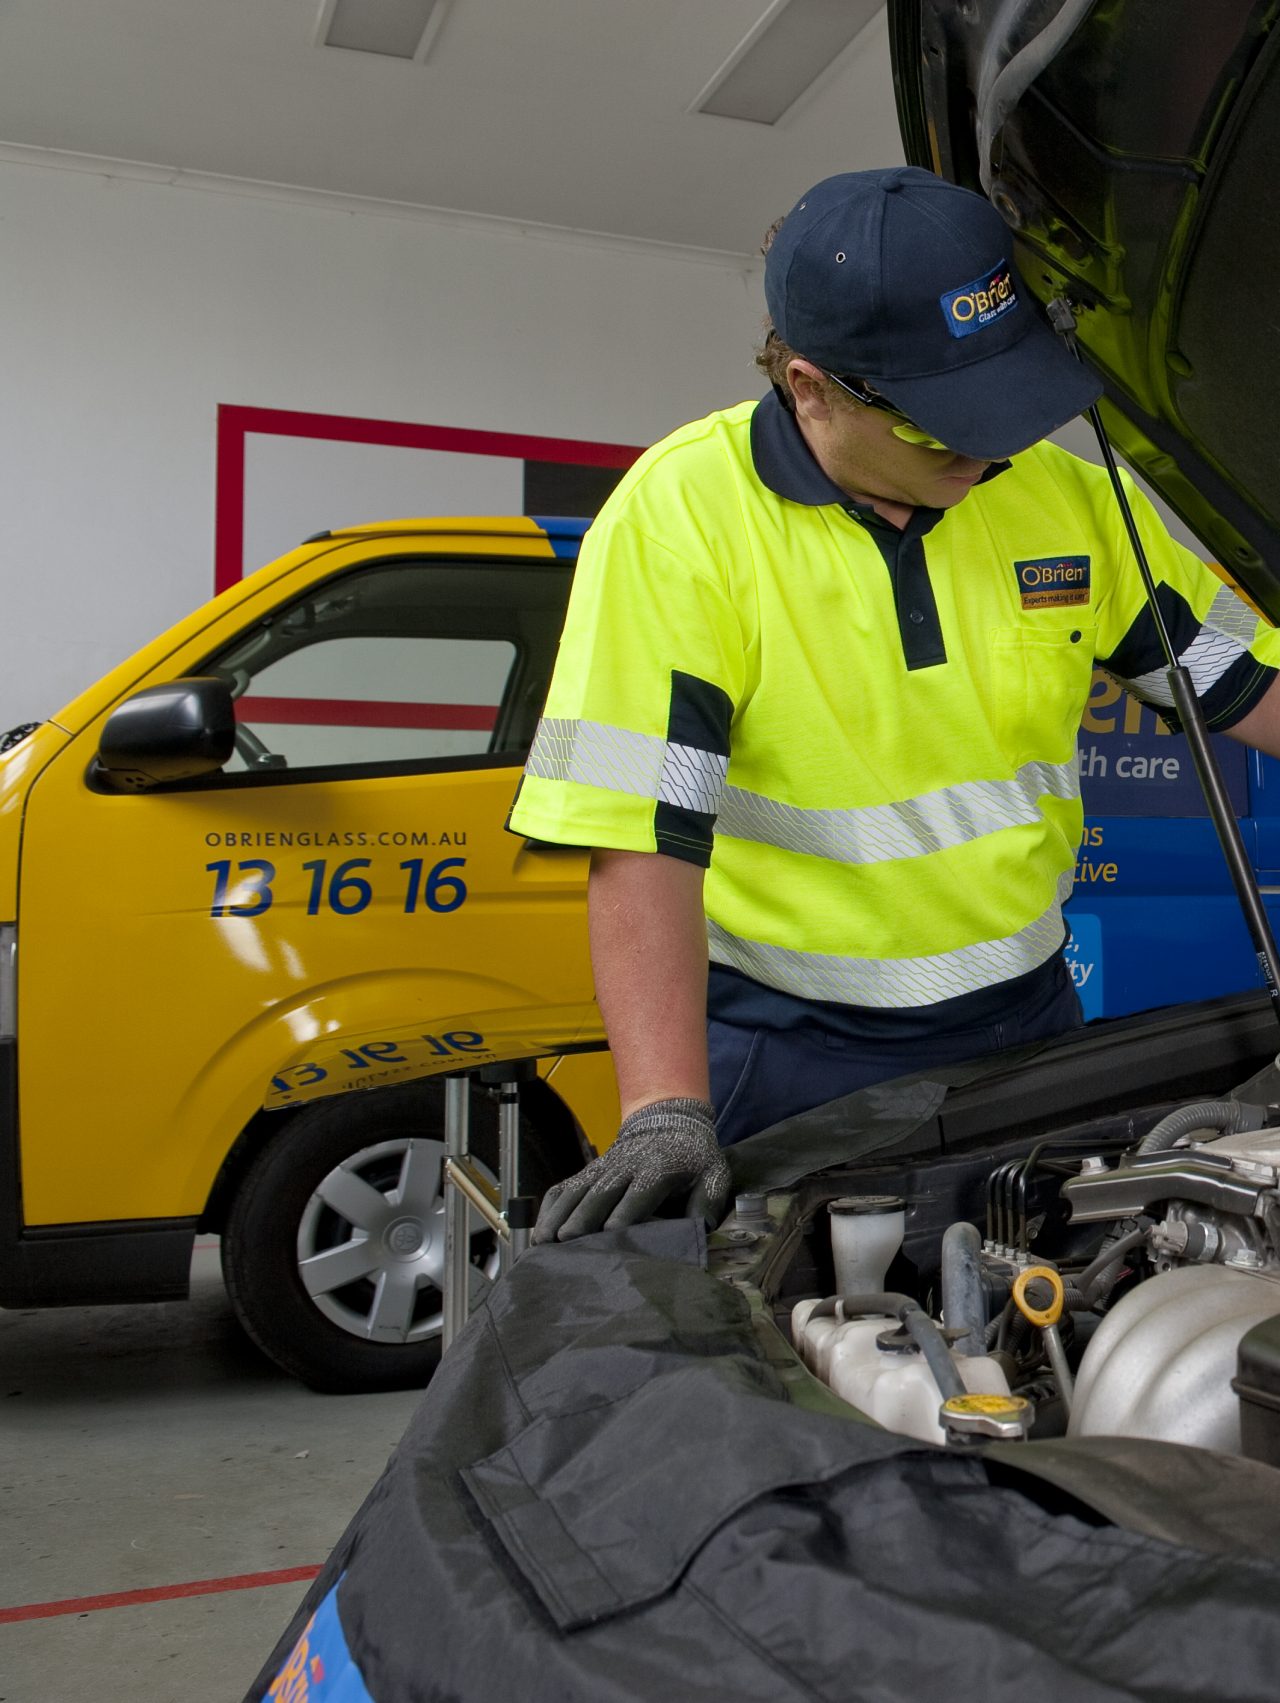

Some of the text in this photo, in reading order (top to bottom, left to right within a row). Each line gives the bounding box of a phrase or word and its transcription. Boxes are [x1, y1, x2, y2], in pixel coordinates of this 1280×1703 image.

[1022, 565, 1083, 586] O'Brien
[1115, 756, 1180, 779] care
[205, 831, 467, 847] OBRIENGLASS.COM.AU
[206, 857, 467, 917] 13 16 16
